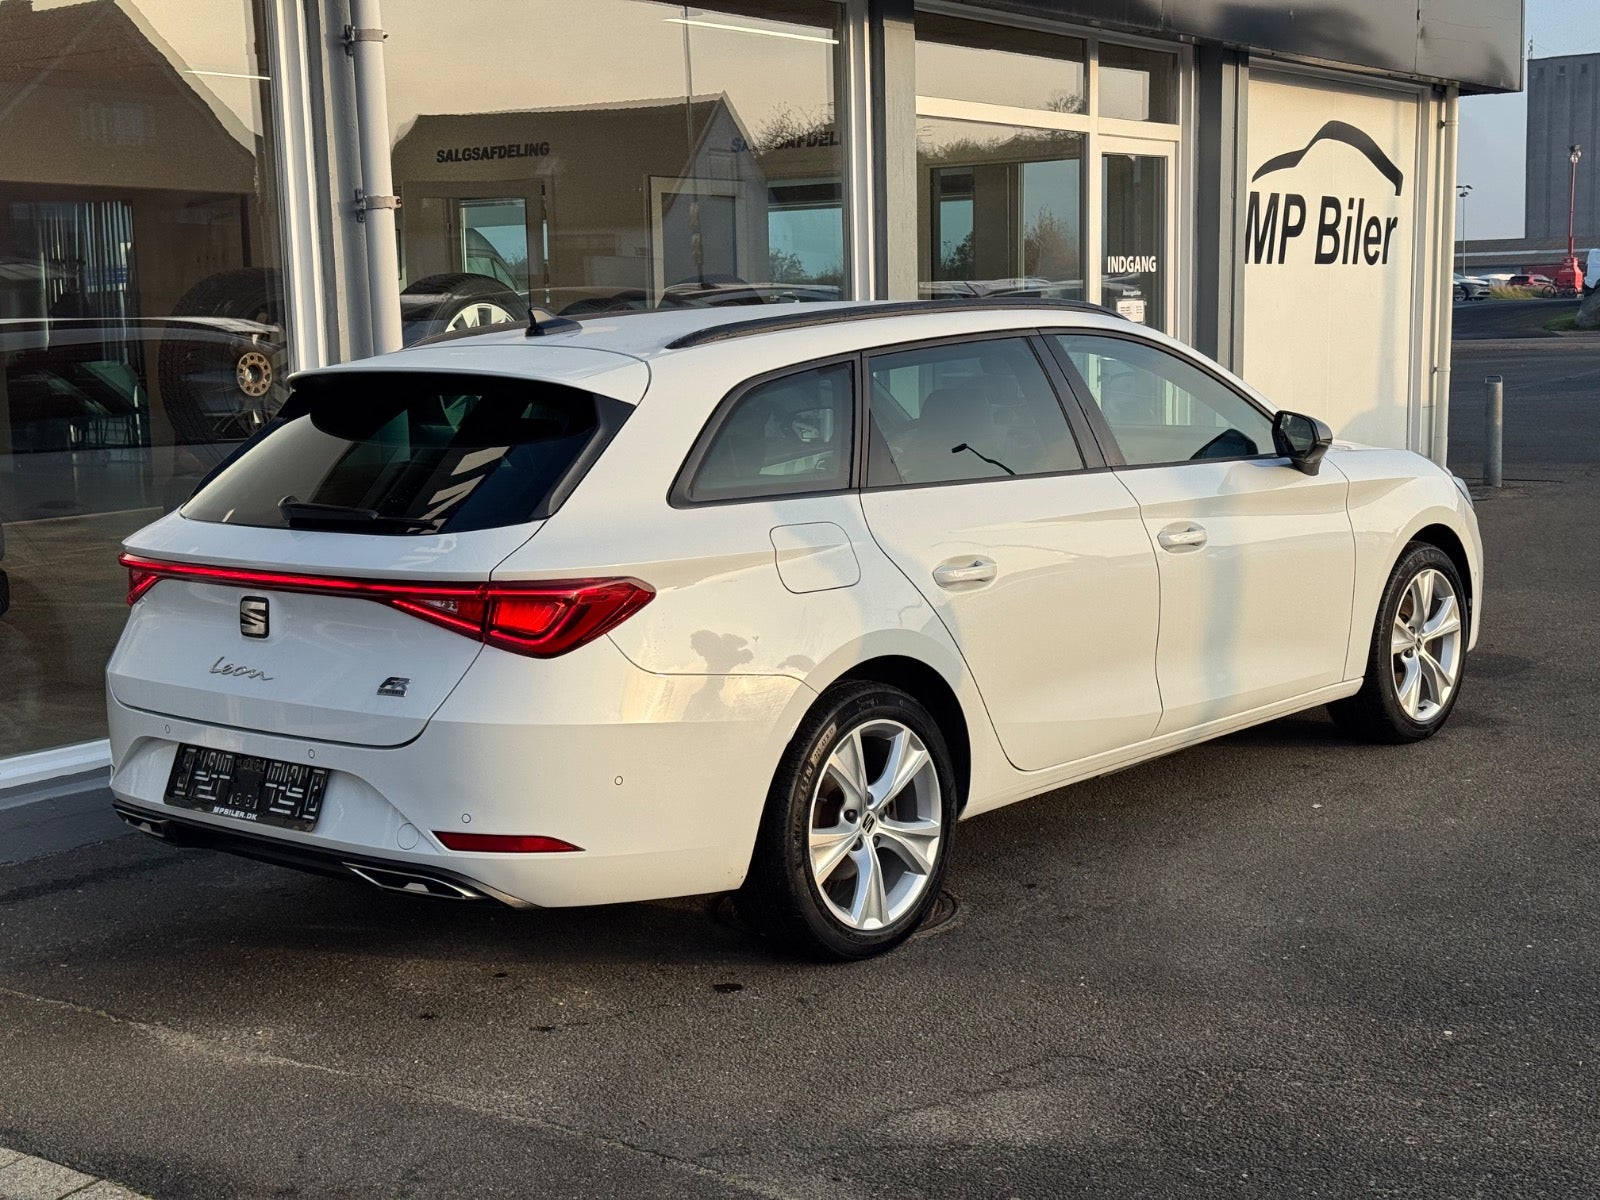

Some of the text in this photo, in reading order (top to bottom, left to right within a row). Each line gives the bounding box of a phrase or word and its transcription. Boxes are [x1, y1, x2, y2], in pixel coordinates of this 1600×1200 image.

[436, 141, 551, 164] SALGSAFDELING
[1245, 191, 1399, 266] MP Biler
[1107, 255, 1157, 273] INDGANG
[209, 656, 274, 682] Leon
[379, 676, 411, 690] FR
[212, 806, 258, 821] MPBILER.DK
